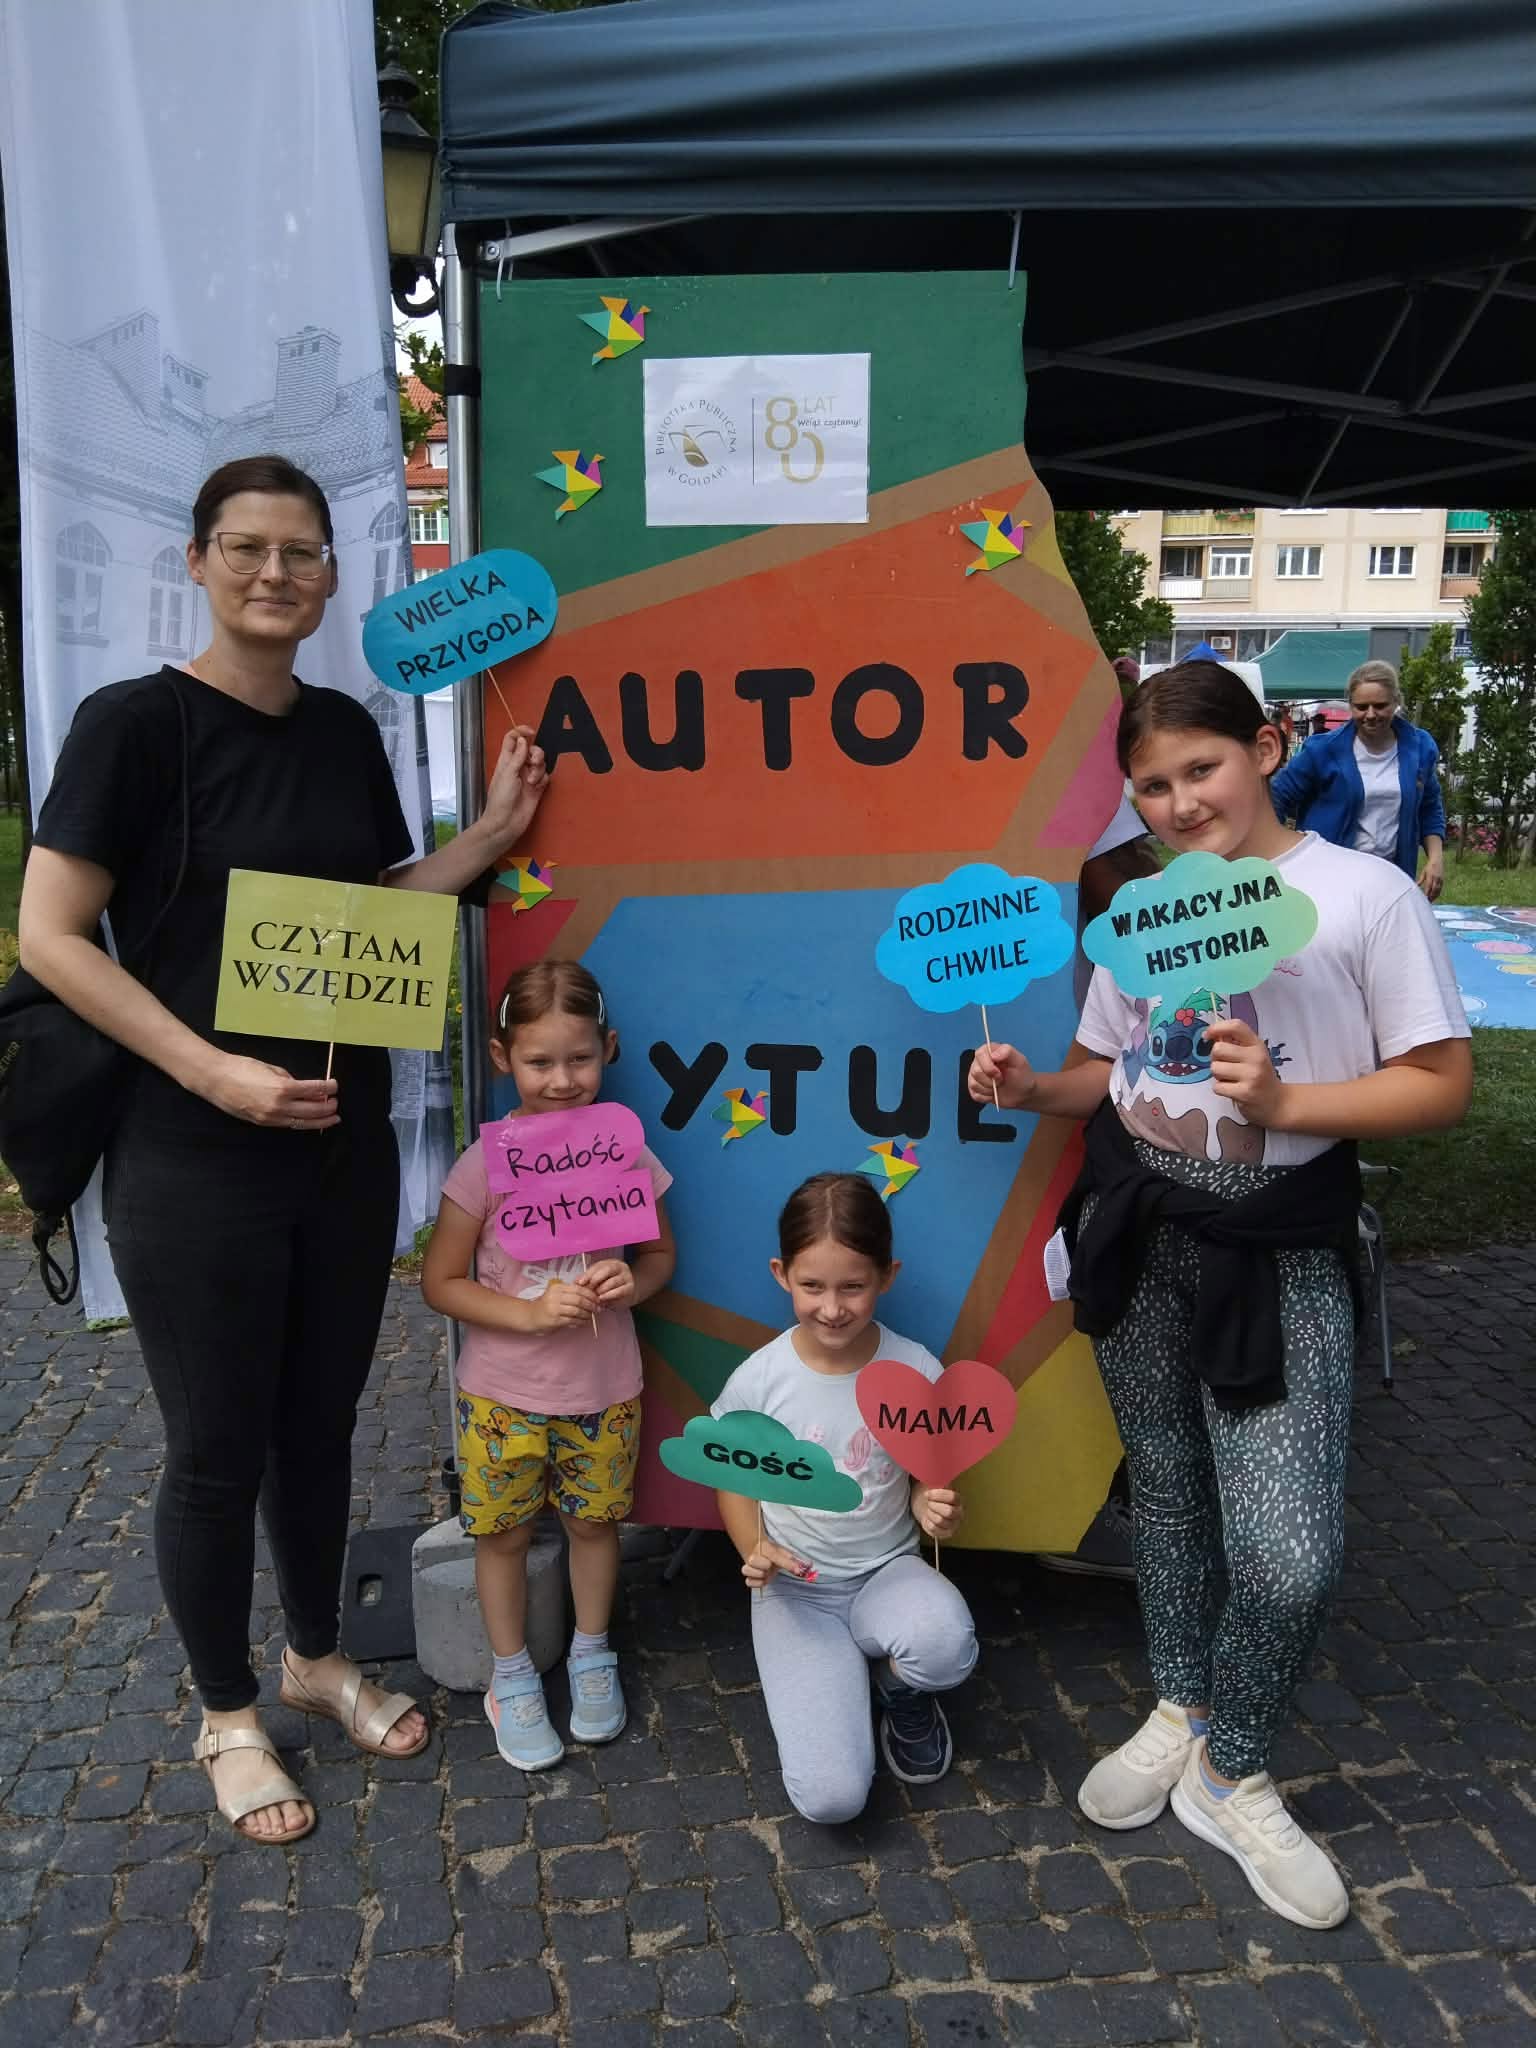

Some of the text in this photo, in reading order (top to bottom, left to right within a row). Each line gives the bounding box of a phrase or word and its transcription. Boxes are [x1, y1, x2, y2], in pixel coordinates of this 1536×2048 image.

[803, 395, 838, 414] LAT
[765, 397, 824, 484] 80
[394, 570, 507, 633] WIELKA
[396, 606, 545, 685] PRZYGODA
[535, 661, 1030, 775] AUTOR
[898, 885, 1041, 942] RODZINNE
[1111, 875, 1282, 938] WAKACYJNA
[250, 921, 423, 966] CZYTAM
[926, 938, 1029, 984] CHWILE
[1146, 925, 1269, 976] HISTORIA
[232, 959, 433, 1007] WSZĘDZIE
[612, 1038, 1018, 1144] YTUŁ
[506, 1133, 625, 1179] Radość
[500, 1184, 646, 1237] czytania
[877, 1402, 995, 1436] MAMA
[702, 1442, 814, 1481] GOŚĆ
